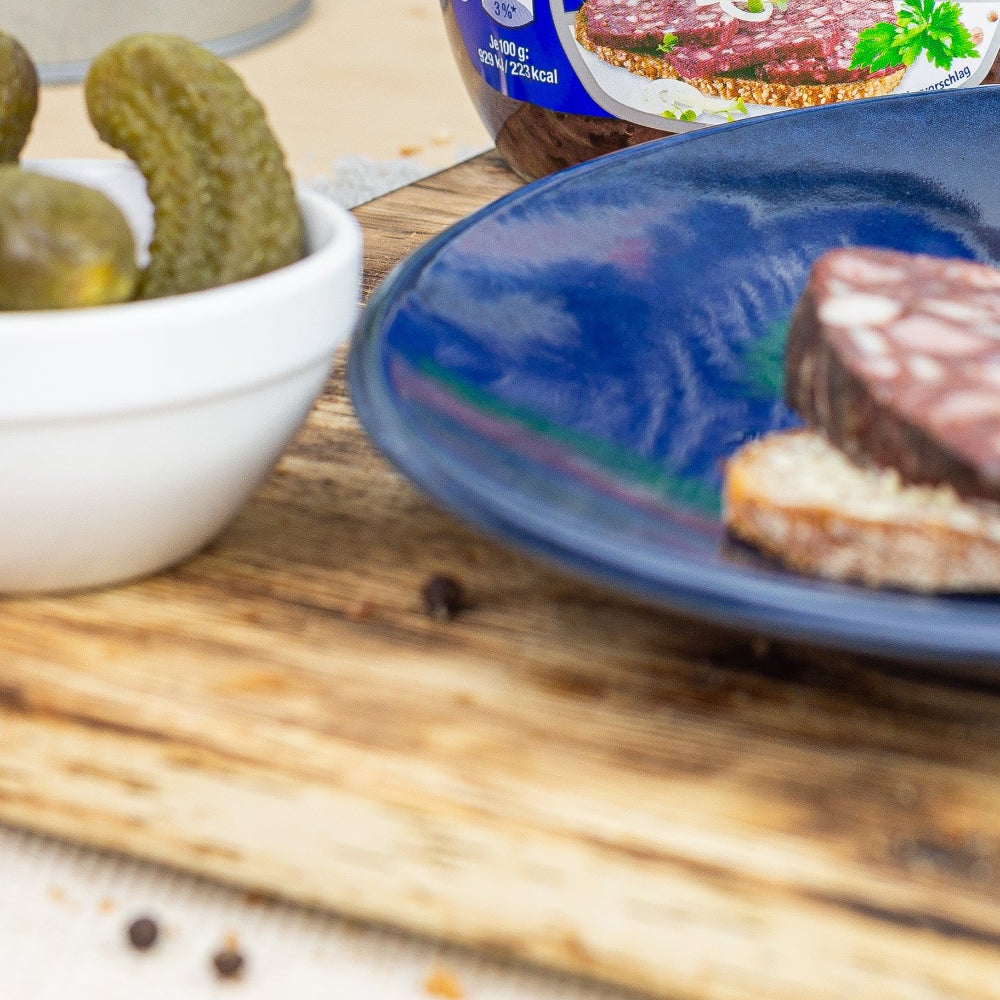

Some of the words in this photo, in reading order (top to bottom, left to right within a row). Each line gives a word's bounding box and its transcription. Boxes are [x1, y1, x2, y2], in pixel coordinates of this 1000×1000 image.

[478, 49, 494, 67] 929
[509, 61, 531, 78] 223
[531, 65, 558, 84] kcal
